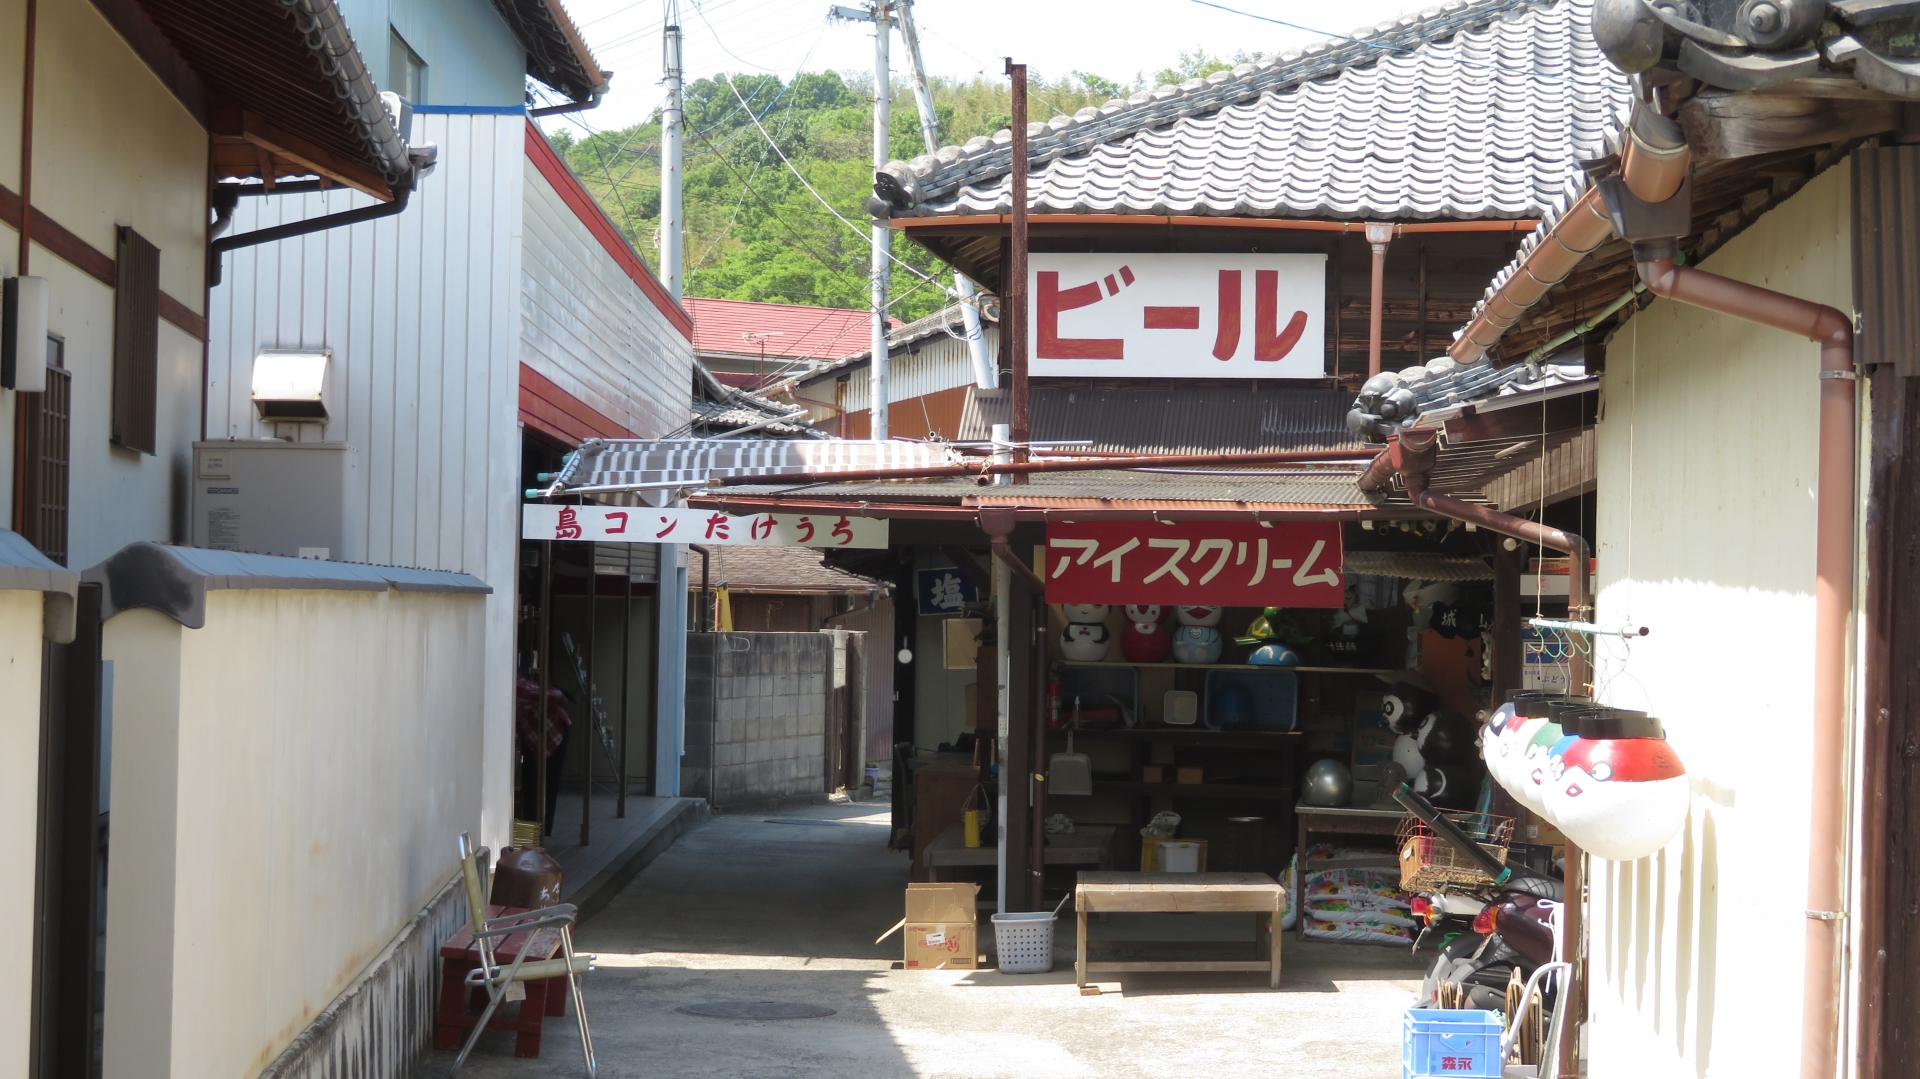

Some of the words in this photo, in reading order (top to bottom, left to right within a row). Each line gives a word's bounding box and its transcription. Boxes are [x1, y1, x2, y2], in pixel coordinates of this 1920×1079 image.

[1036, 265, 1309, 362] ビール
[1049, 536, 1340, 587] アイスクリーム
[931, 573, 965, 610] 塩
[1441, 1056, 1473, 1070] 森永
